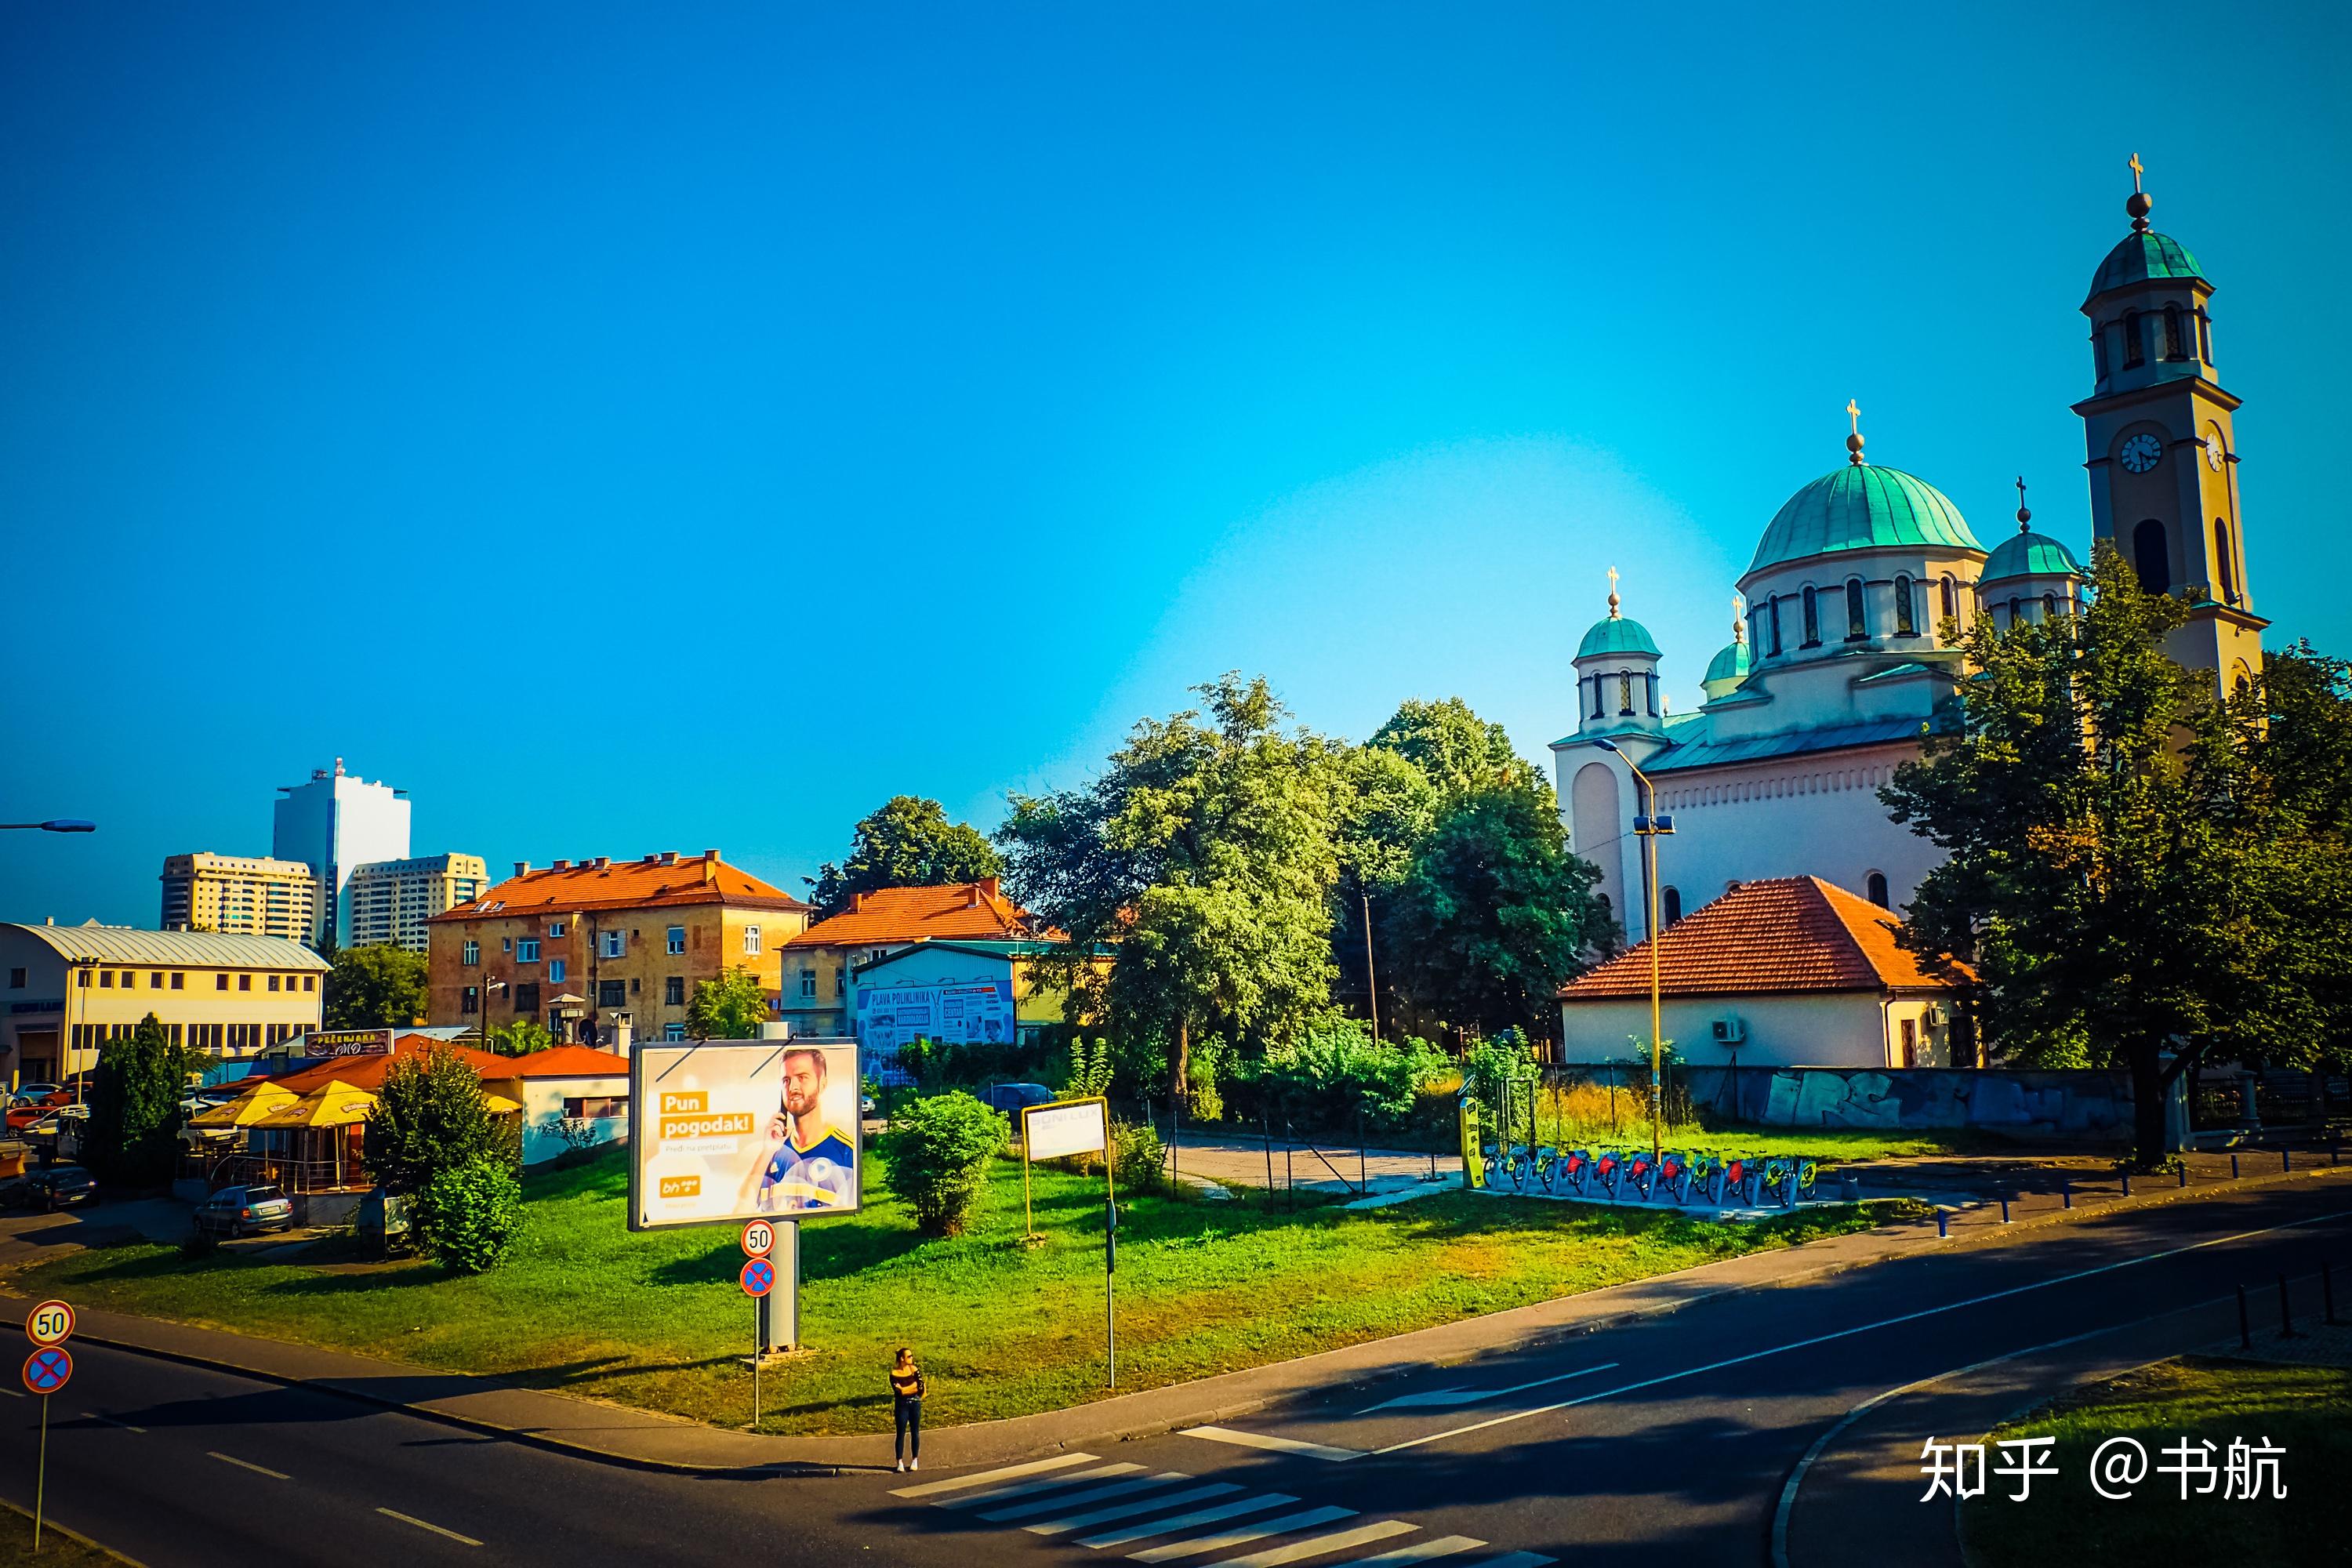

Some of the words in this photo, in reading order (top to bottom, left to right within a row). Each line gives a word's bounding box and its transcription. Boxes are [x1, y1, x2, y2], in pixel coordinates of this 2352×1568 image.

[872, 993, 891, 1006] PLAVA
[892, 991, 930, 1004] POLIKLINIKA
[665, 1095, 700, 1112] Pun
[665, 1116, 749, 1140] pogodak!
[750, 1230, 768, 1248] 50
[38, 1312, 64, 1335] 50
